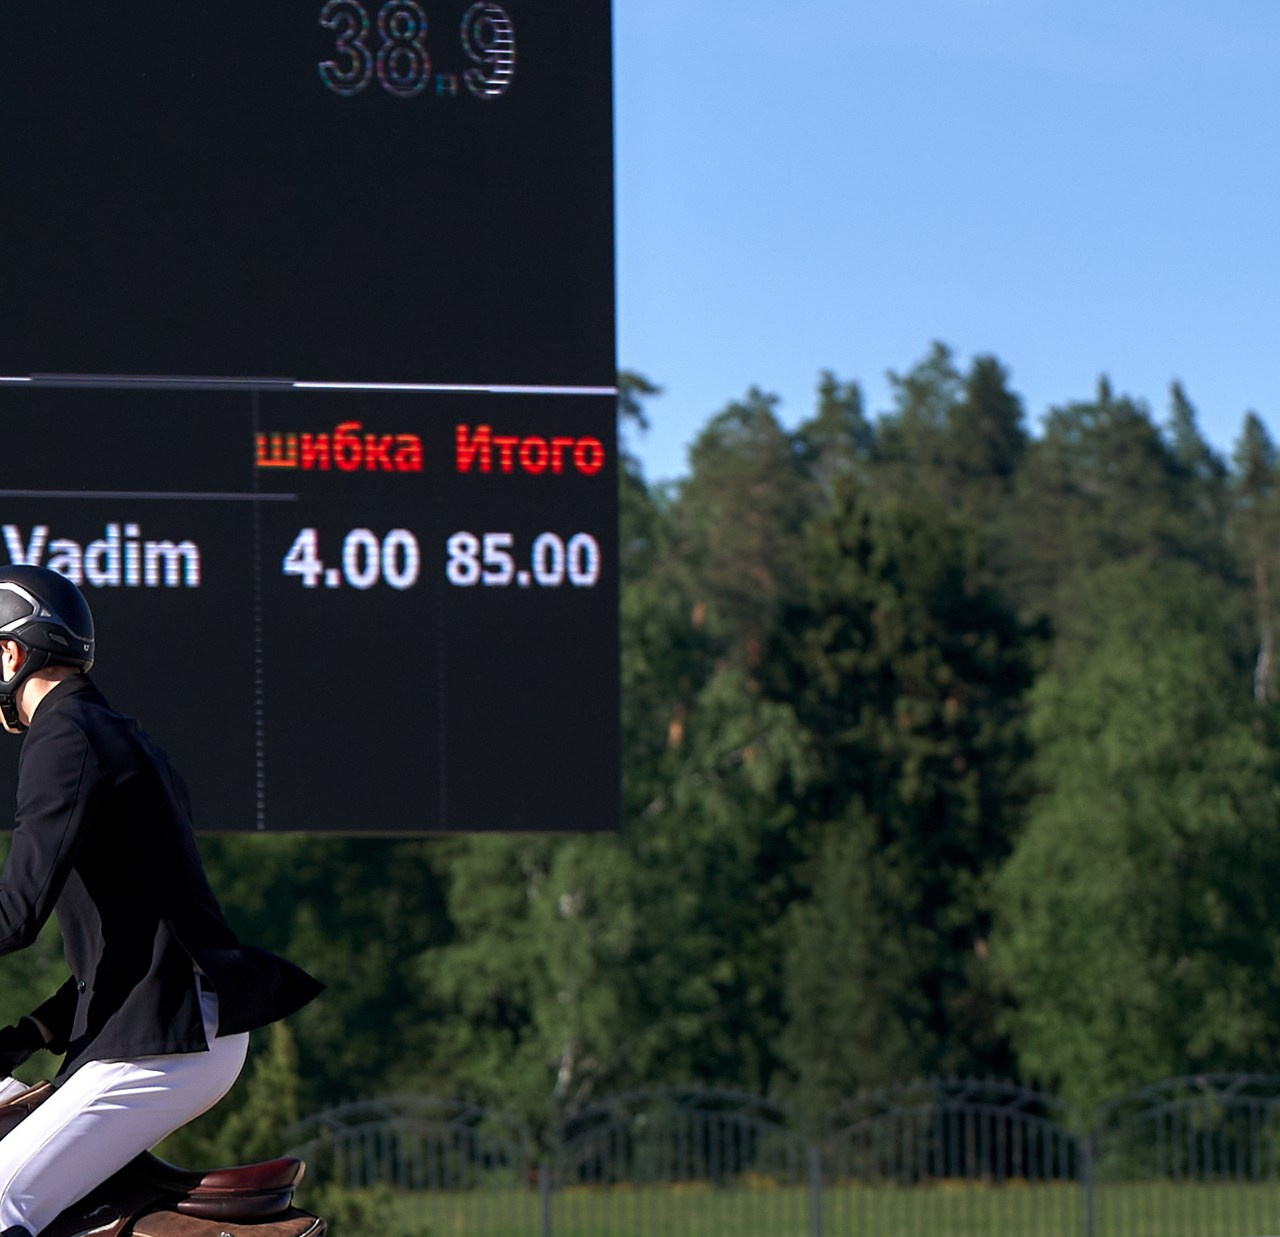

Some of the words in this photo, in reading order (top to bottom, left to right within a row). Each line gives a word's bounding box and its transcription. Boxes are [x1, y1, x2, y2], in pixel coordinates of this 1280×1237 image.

[318, 0, 516, 98] 38.9
[255, 420, 424, 472] шибка
[456, 424, 605, 476] Итого
[1, 522, 201, 588] Vadim
[281, 526, 420, 591] 4.00
[445, 530, 602, 588] 85.00
